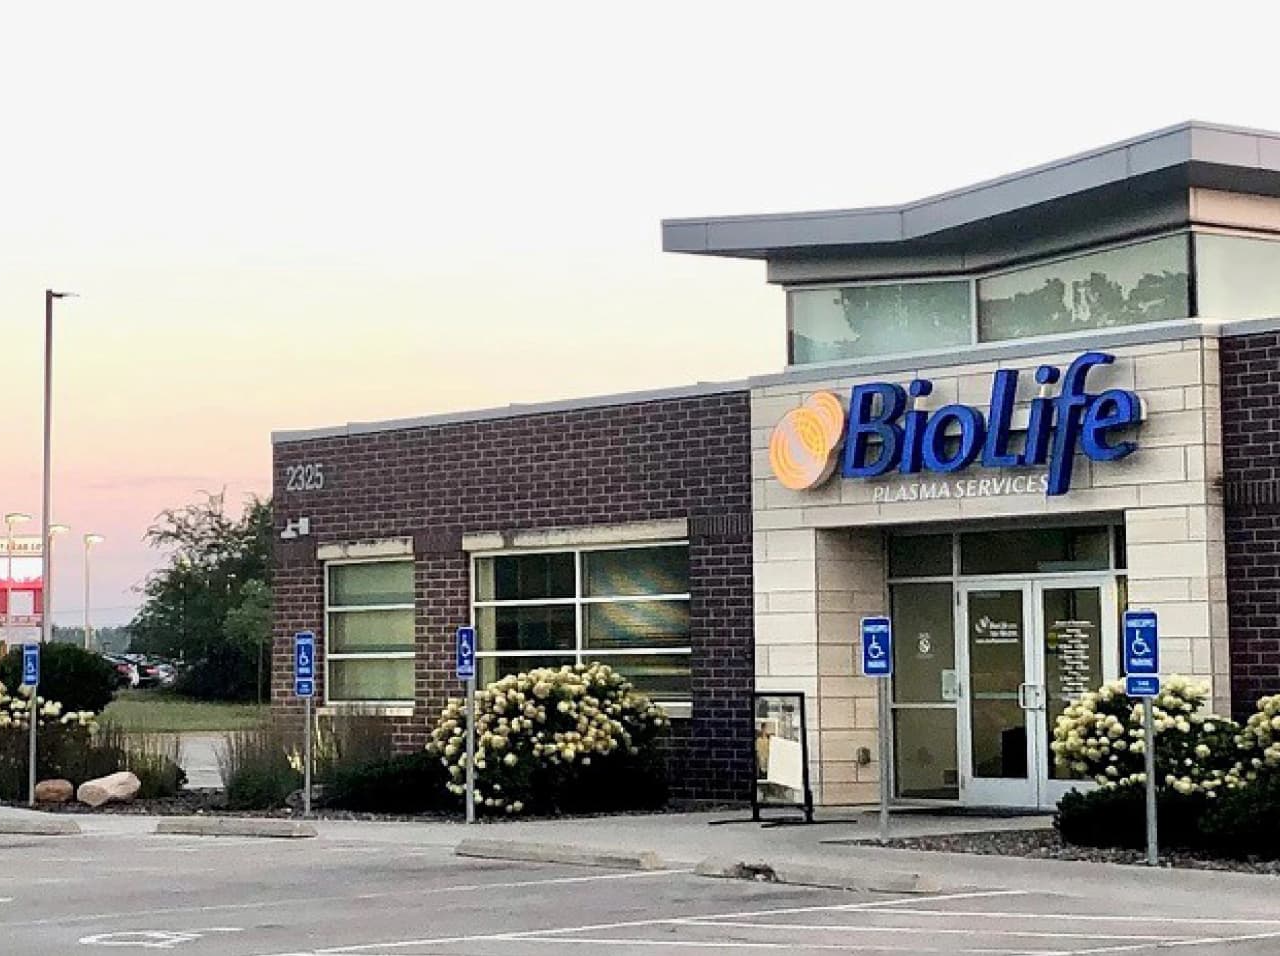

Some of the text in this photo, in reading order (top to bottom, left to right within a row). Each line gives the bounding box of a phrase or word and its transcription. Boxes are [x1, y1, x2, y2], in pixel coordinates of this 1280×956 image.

[842, 351, 1143, 497] BioLife
[286, 463, 324, 491] 2325
[872, 474, 1049, 504] PLASMA SERVICES
